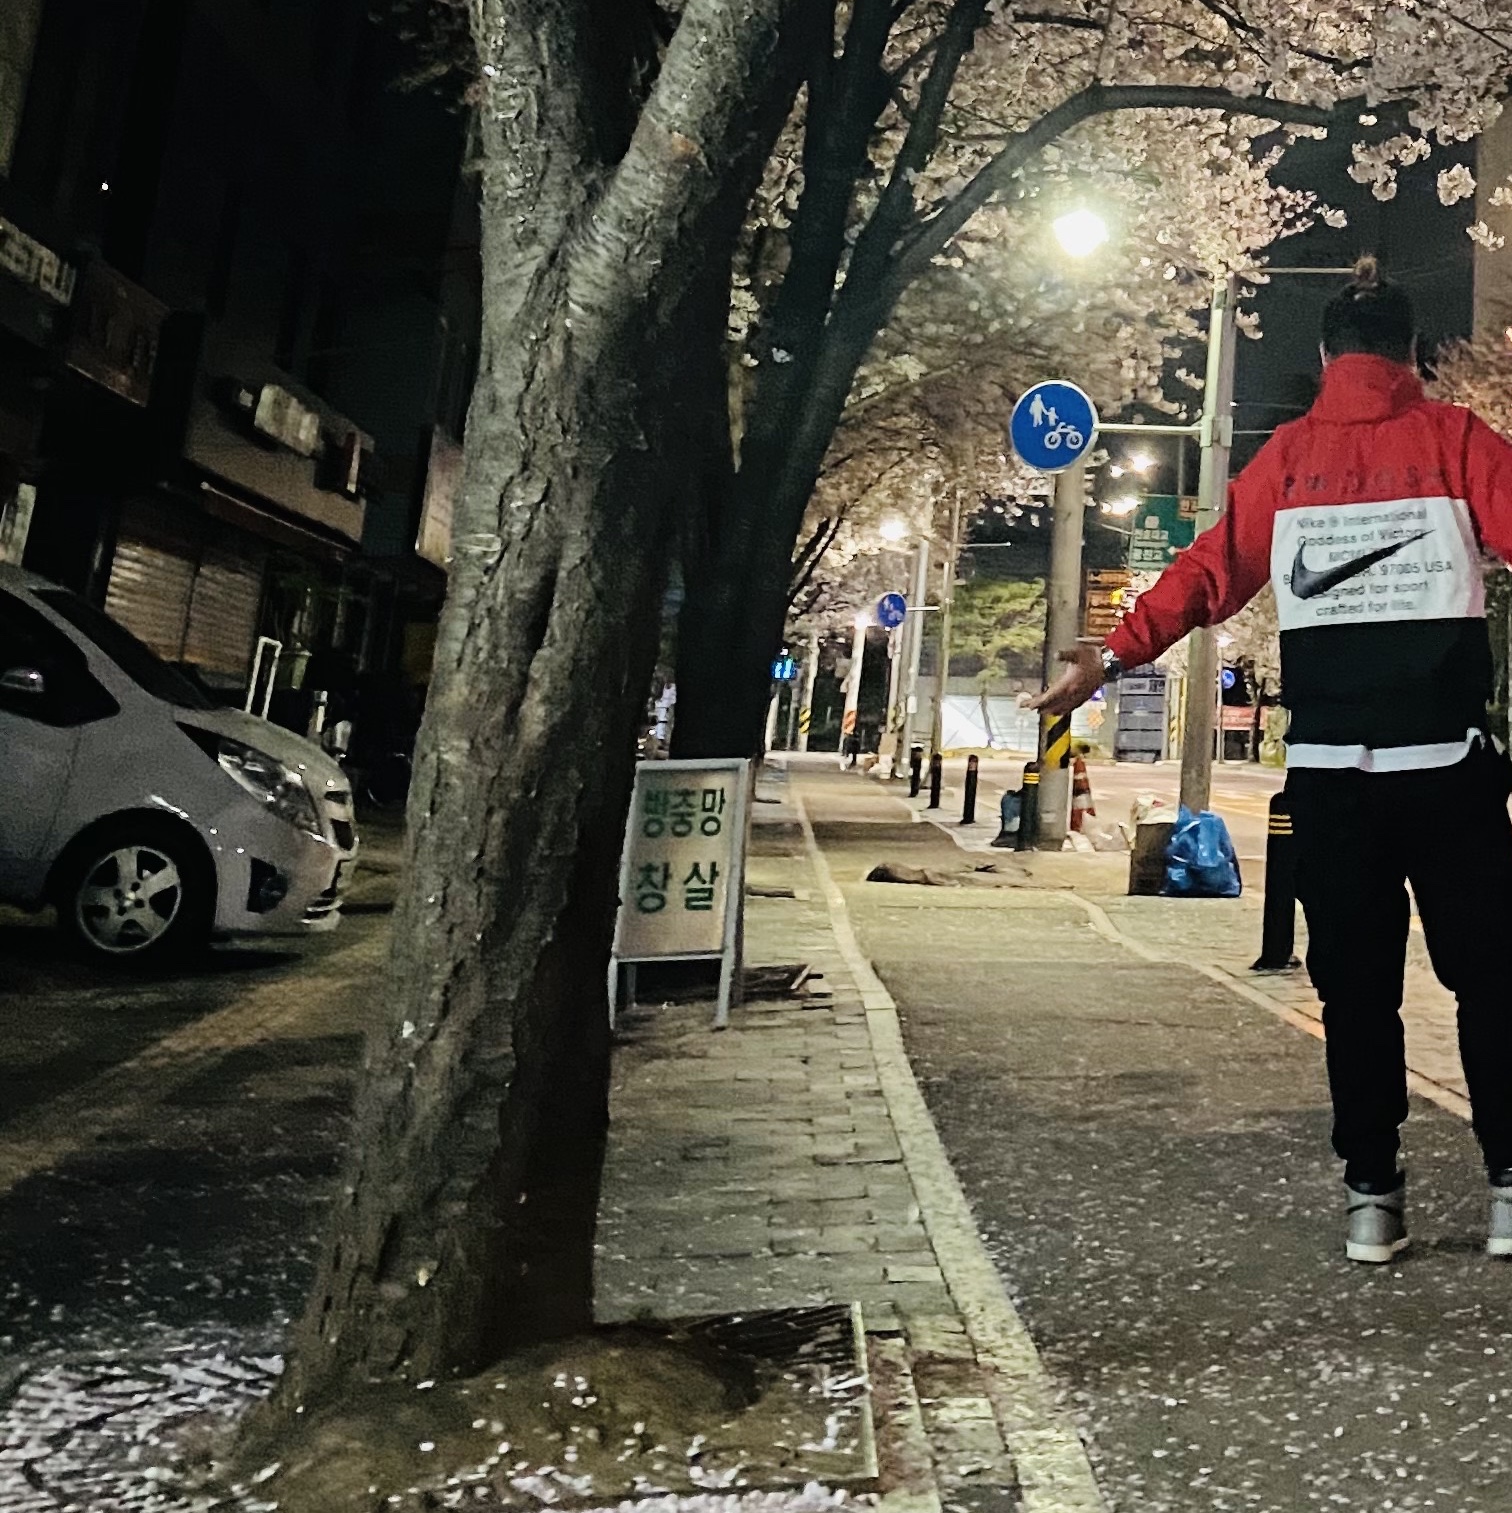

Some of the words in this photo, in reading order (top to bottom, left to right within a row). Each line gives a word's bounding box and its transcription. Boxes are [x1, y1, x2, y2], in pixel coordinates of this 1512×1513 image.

[1297, 517, 1326, 529] Nike
[1343, 507, 1428, 526] International
[1297, 534, 1357, 547] Goddess
[1361, 530, 1374, 541] of
[1424, 559, 1454, 573] USA
[1370, 581, 1388, 595] for
[1315, 600, 1364, 617] crafted
[1368, 599, 1388, 613] for
[643, 786, 726, 838] 방충망
[636, 860, 720, 914] 창살
